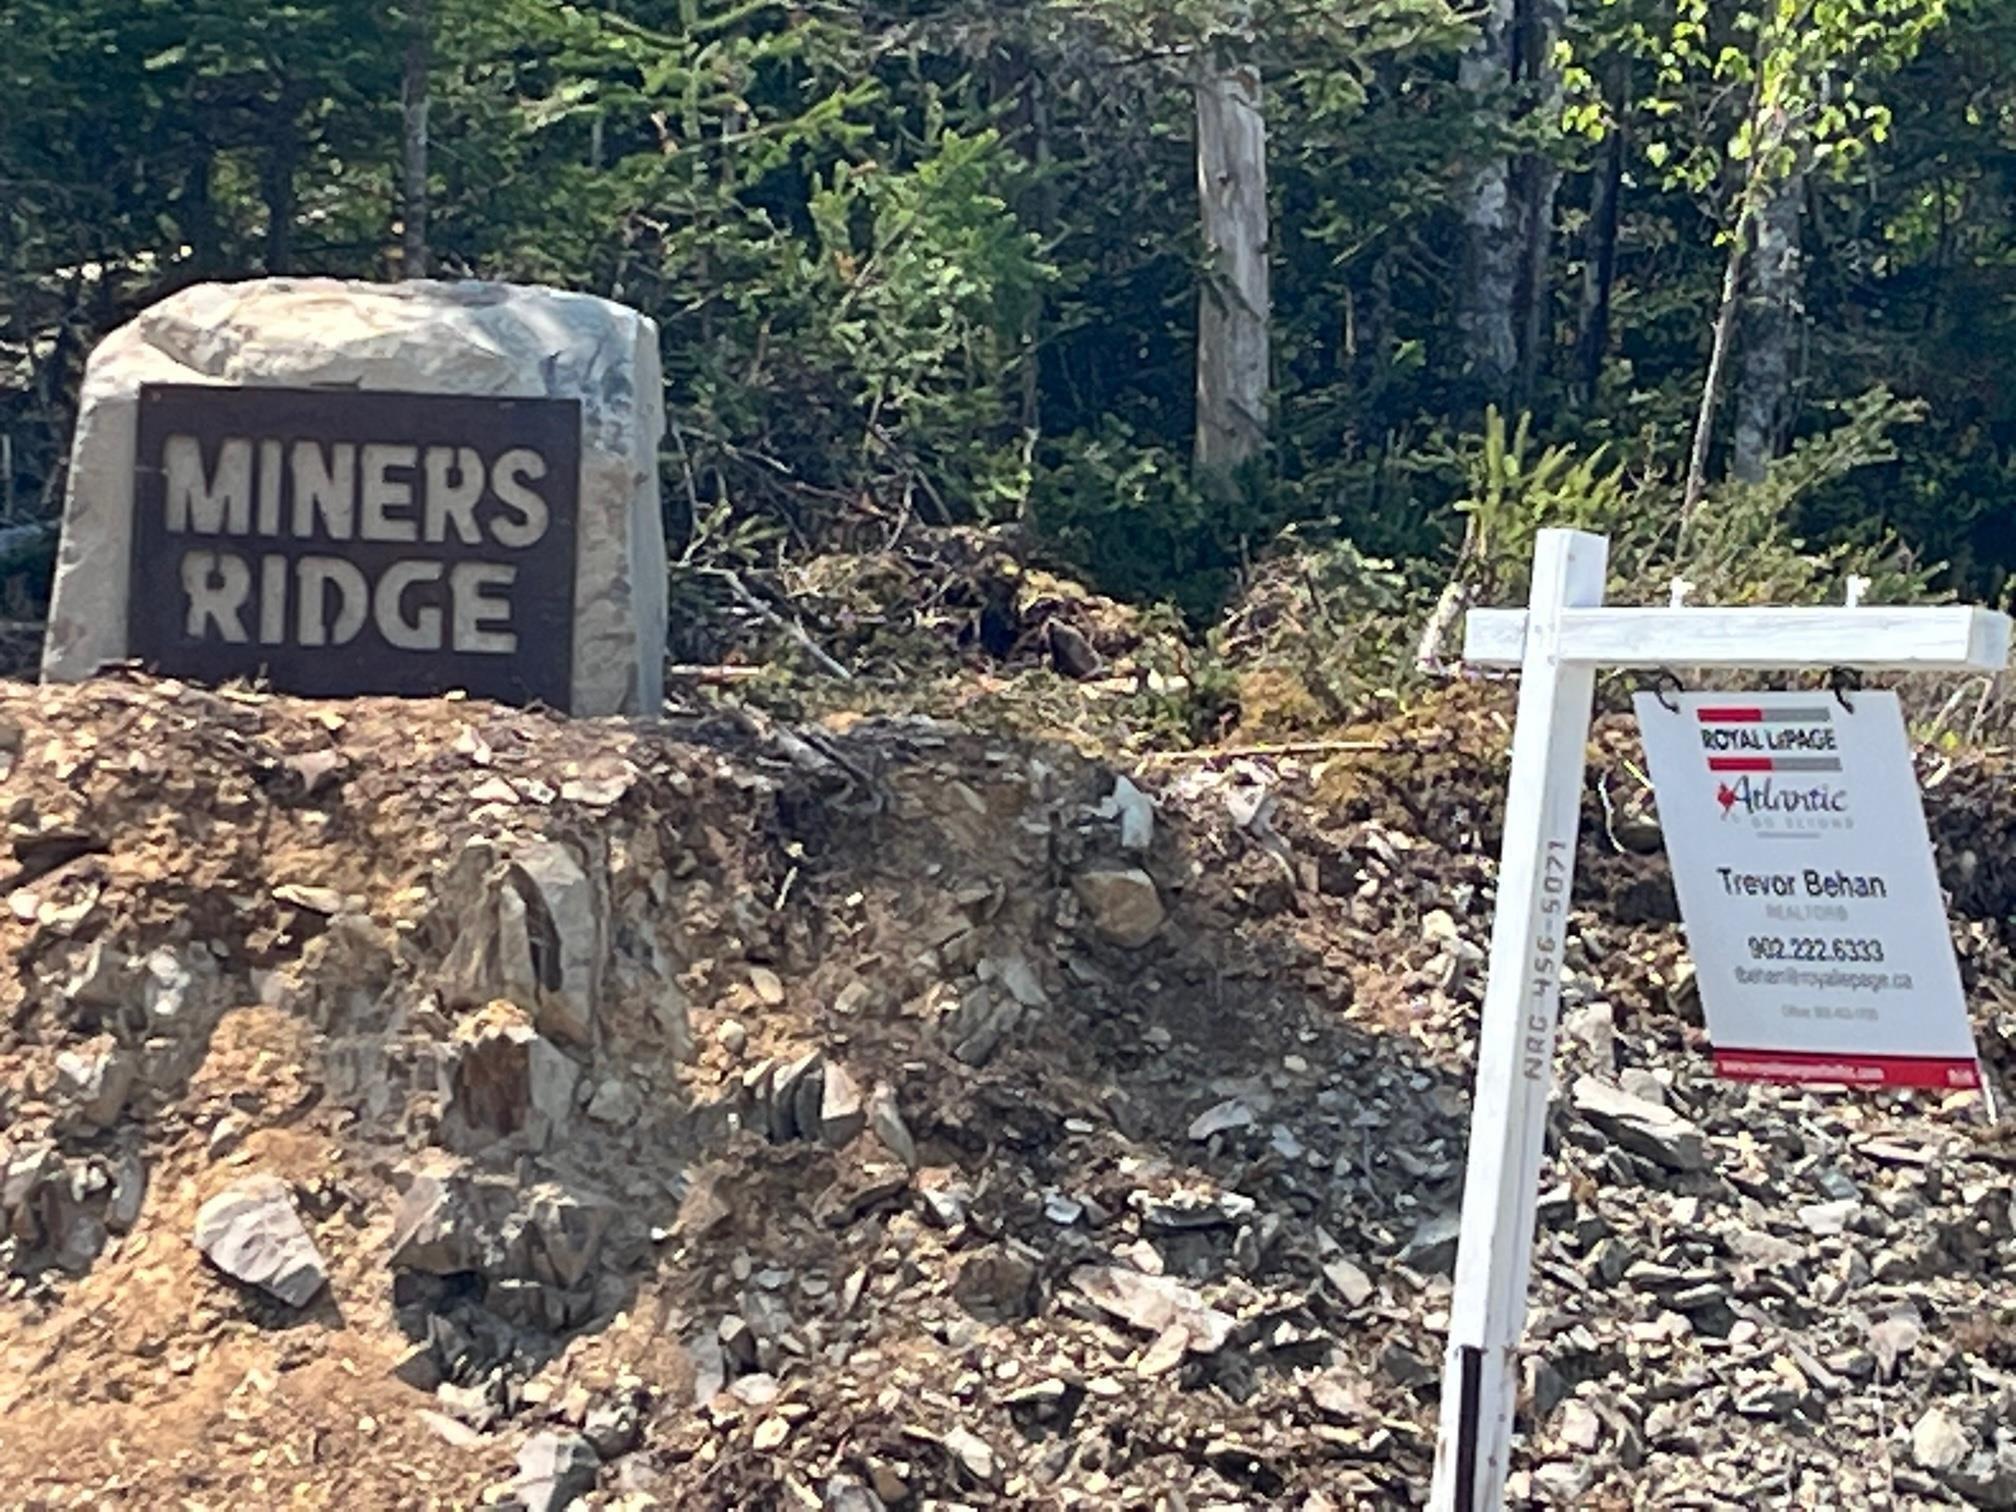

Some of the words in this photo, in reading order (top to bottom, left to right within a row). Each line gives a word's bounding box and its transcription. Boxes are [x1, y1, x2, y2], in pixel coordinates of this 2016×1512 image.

[163, 433, 549, 548] MINERS
[180, 549, 518, 654] RIDGE
[1701, 728, 1764, 750] ROYAL
[1732, 774, 1849, 813] Atlantic
[1716, 867, 1795, 896] Trevor
[1803, 869, 1887, 898] Behan
[1748, 936, 1884, 962] 902.222.6333
[1523, 1014, 1548, 1081] NRG
